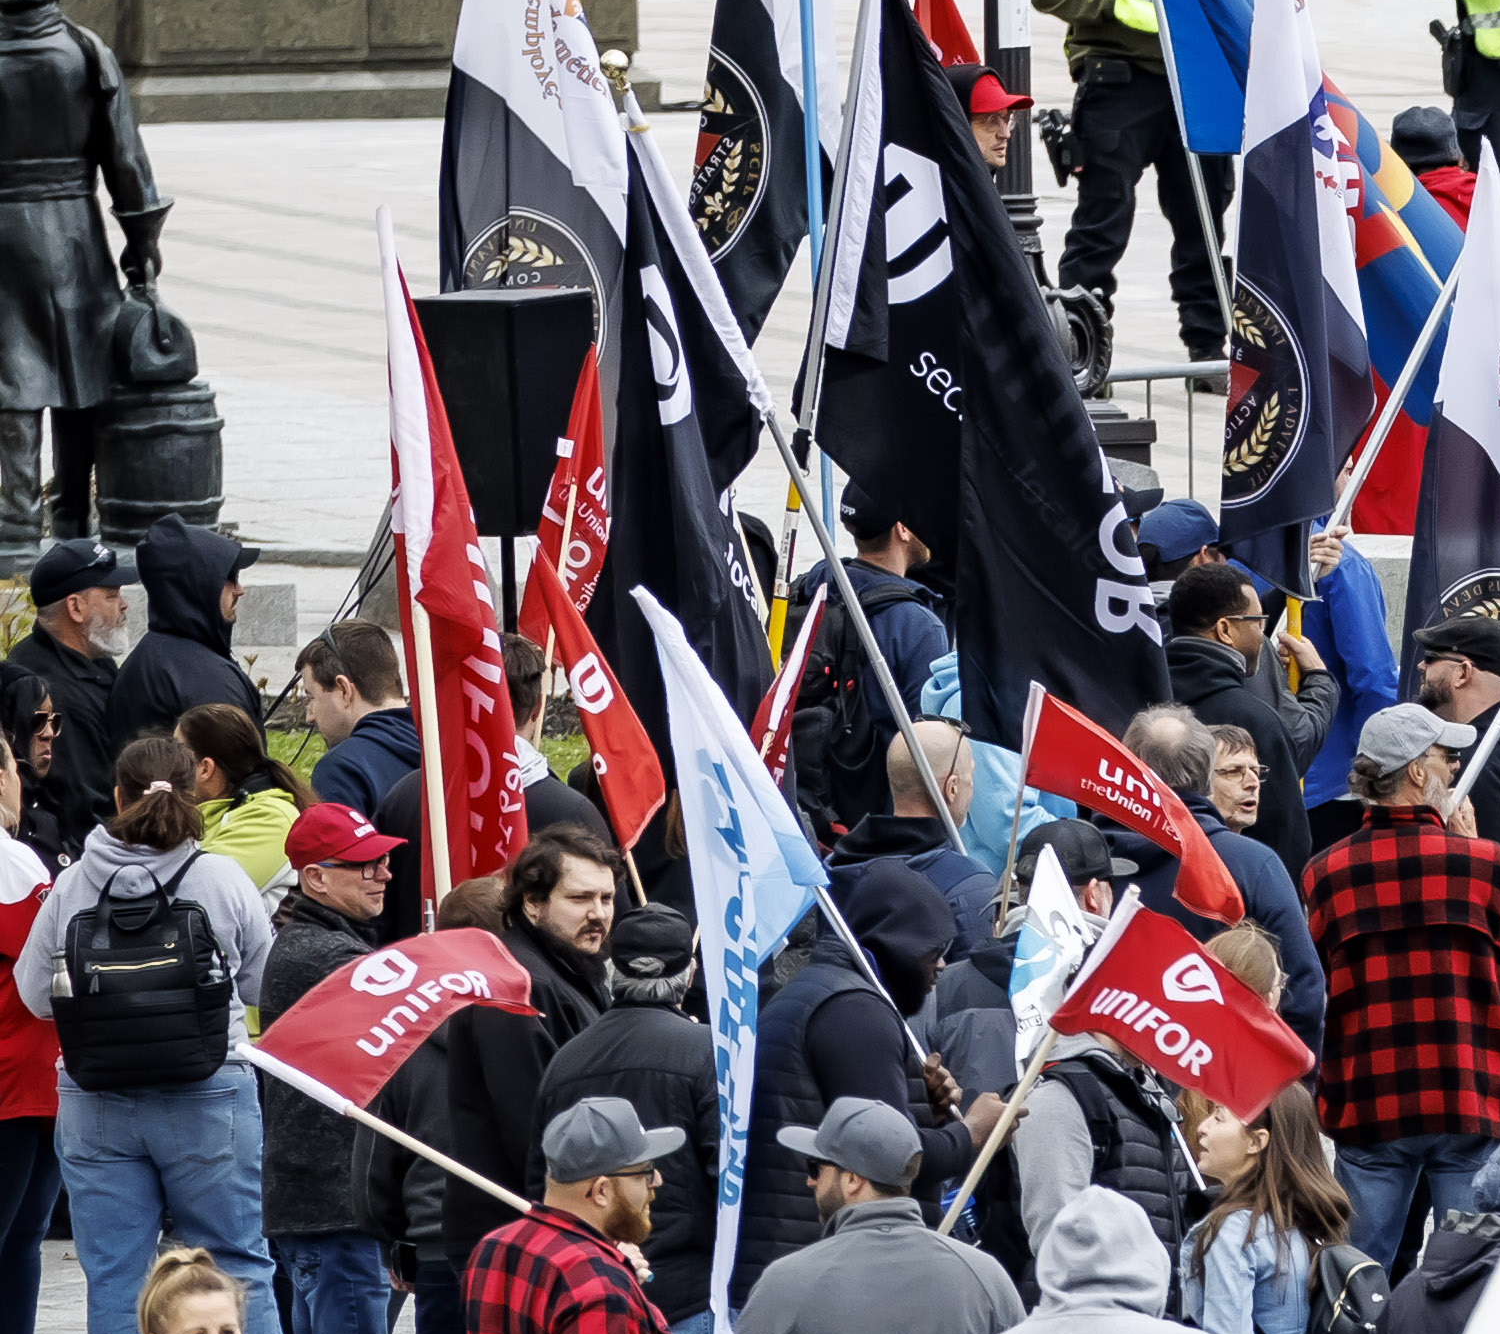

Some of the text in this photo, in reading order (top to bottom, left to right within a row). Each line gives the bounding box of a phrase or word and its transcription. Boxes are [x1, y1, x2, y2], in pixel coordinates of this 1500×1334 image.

[1080, 777, 1152, 823] theUnion
[356, 969, 491, 1058] UNIFOR
[1091, 987, 1214, 1075] UNIFOR
